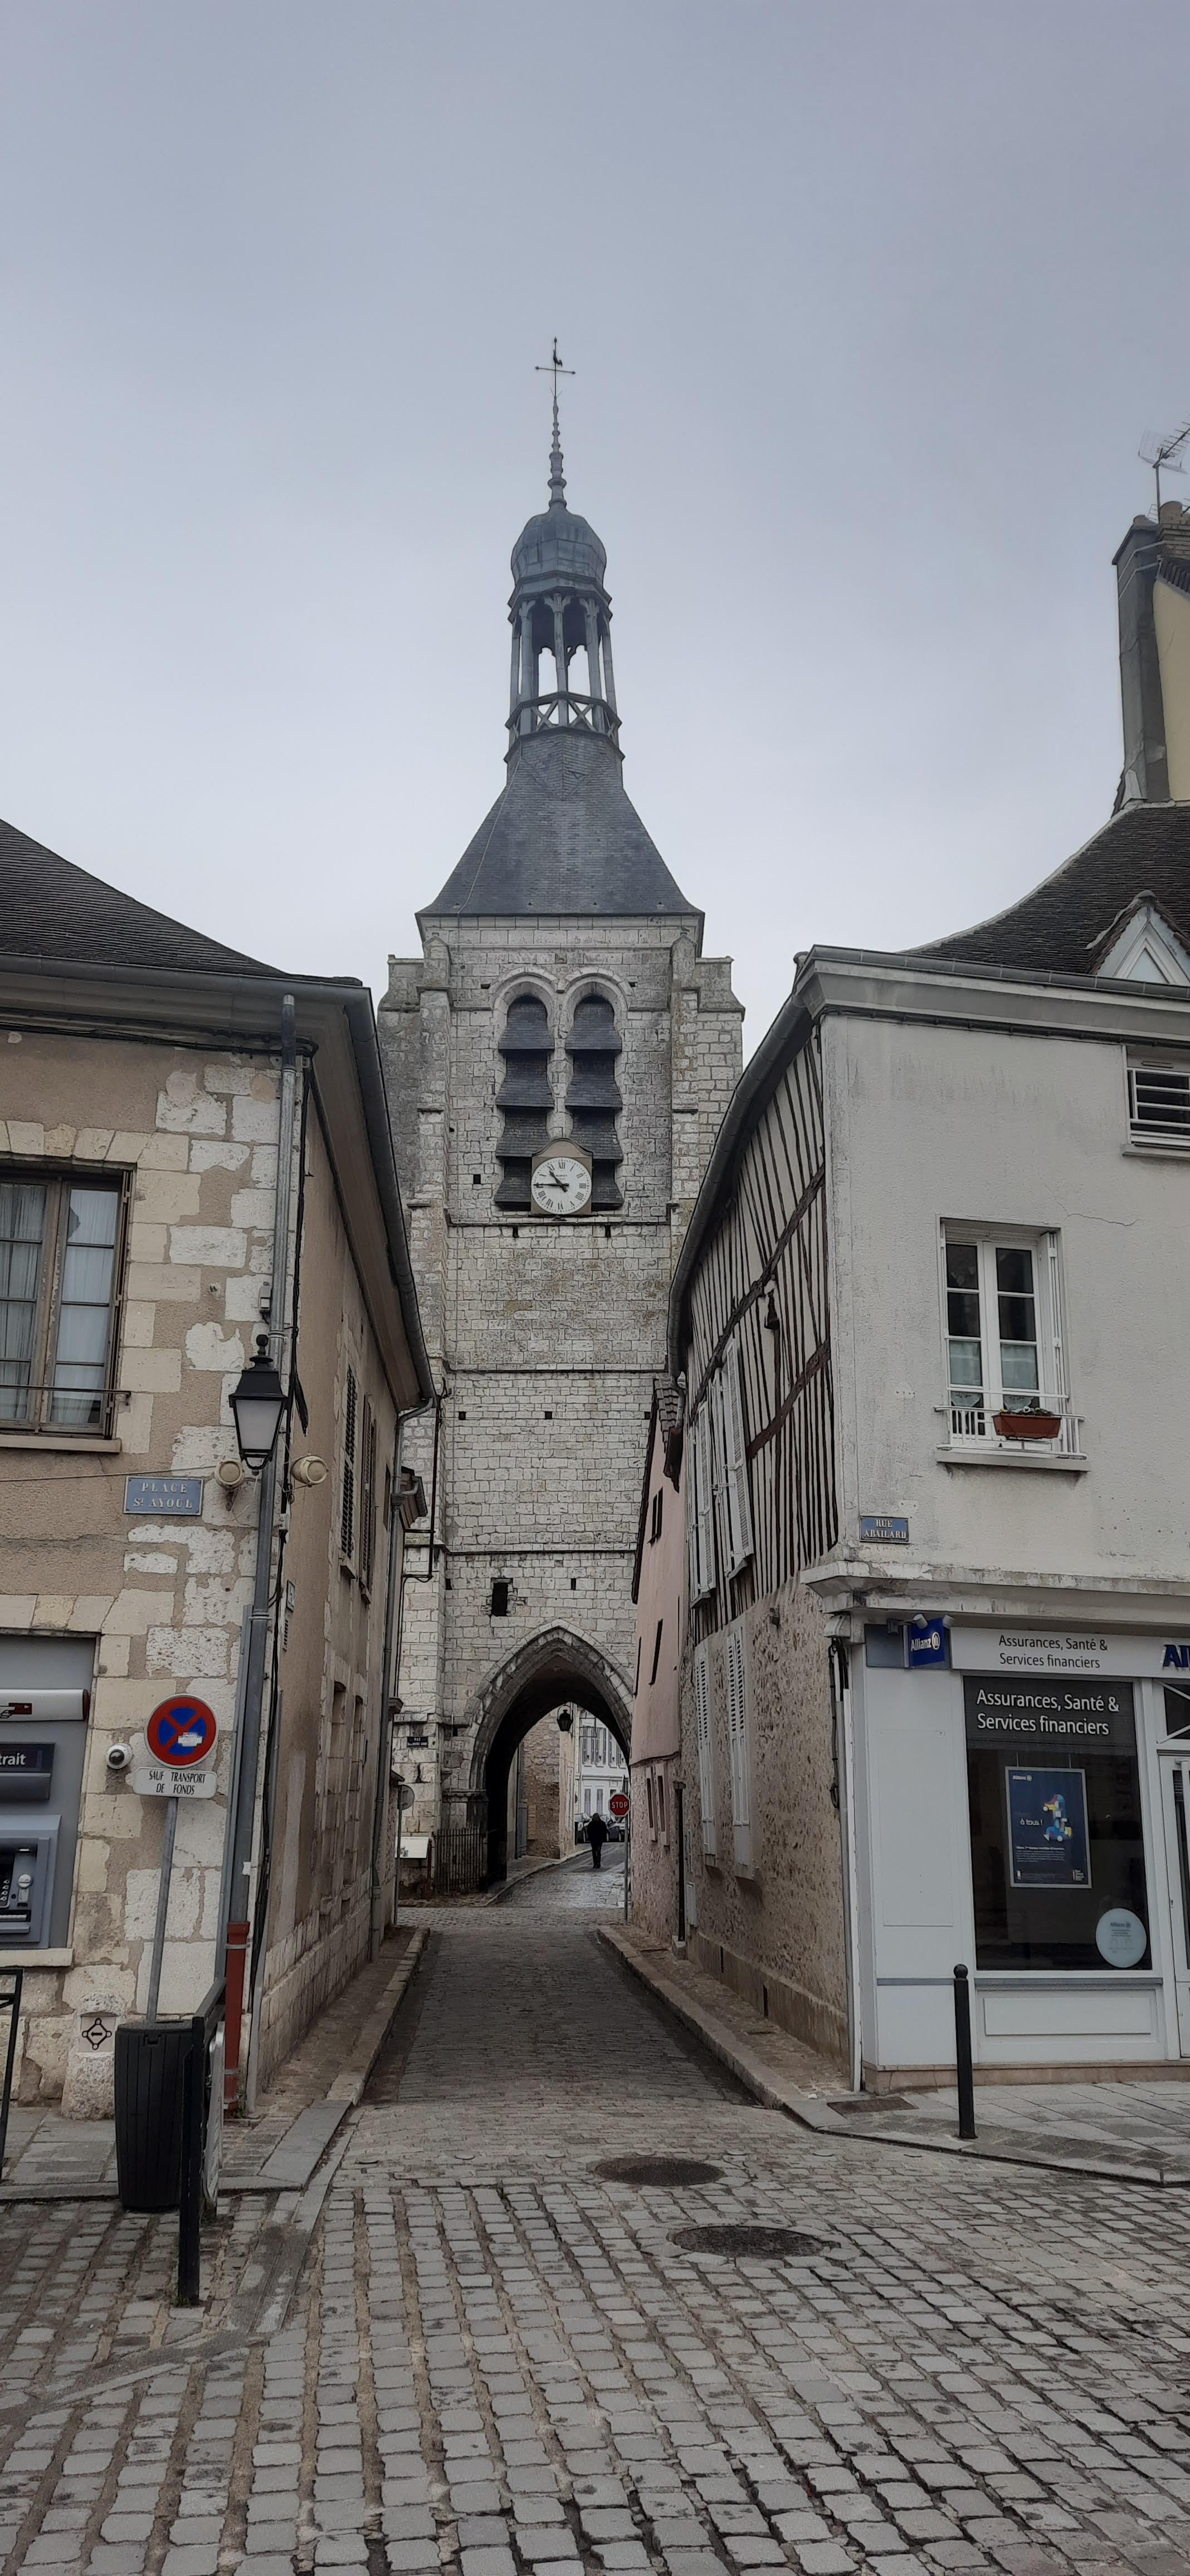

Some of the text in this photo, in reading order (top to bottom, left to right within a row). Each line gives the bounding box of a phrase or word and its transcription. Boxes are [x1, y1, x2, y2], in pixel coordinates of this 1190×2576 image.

[141, 1482, 187, 1493] PLACE
[148, 1497, 192, 1509] AYOUL
[864, 1529, 906, 1539] ABAILARD
[910, 1638, 932, 1652] Allianz
[999, 1635, 1108, 1651] Assurances, Santé &
[999, 1652, 1100, 1668] Services financiers
[977, 1689, 1119, 1712] Assurances, Santé &
[977, 1713, 1109, 1735] Services financiers
[149, 1770, 206, 1783] SAUF TRANSPORT
[156, 1783, 195, 1795] DE FONDS
